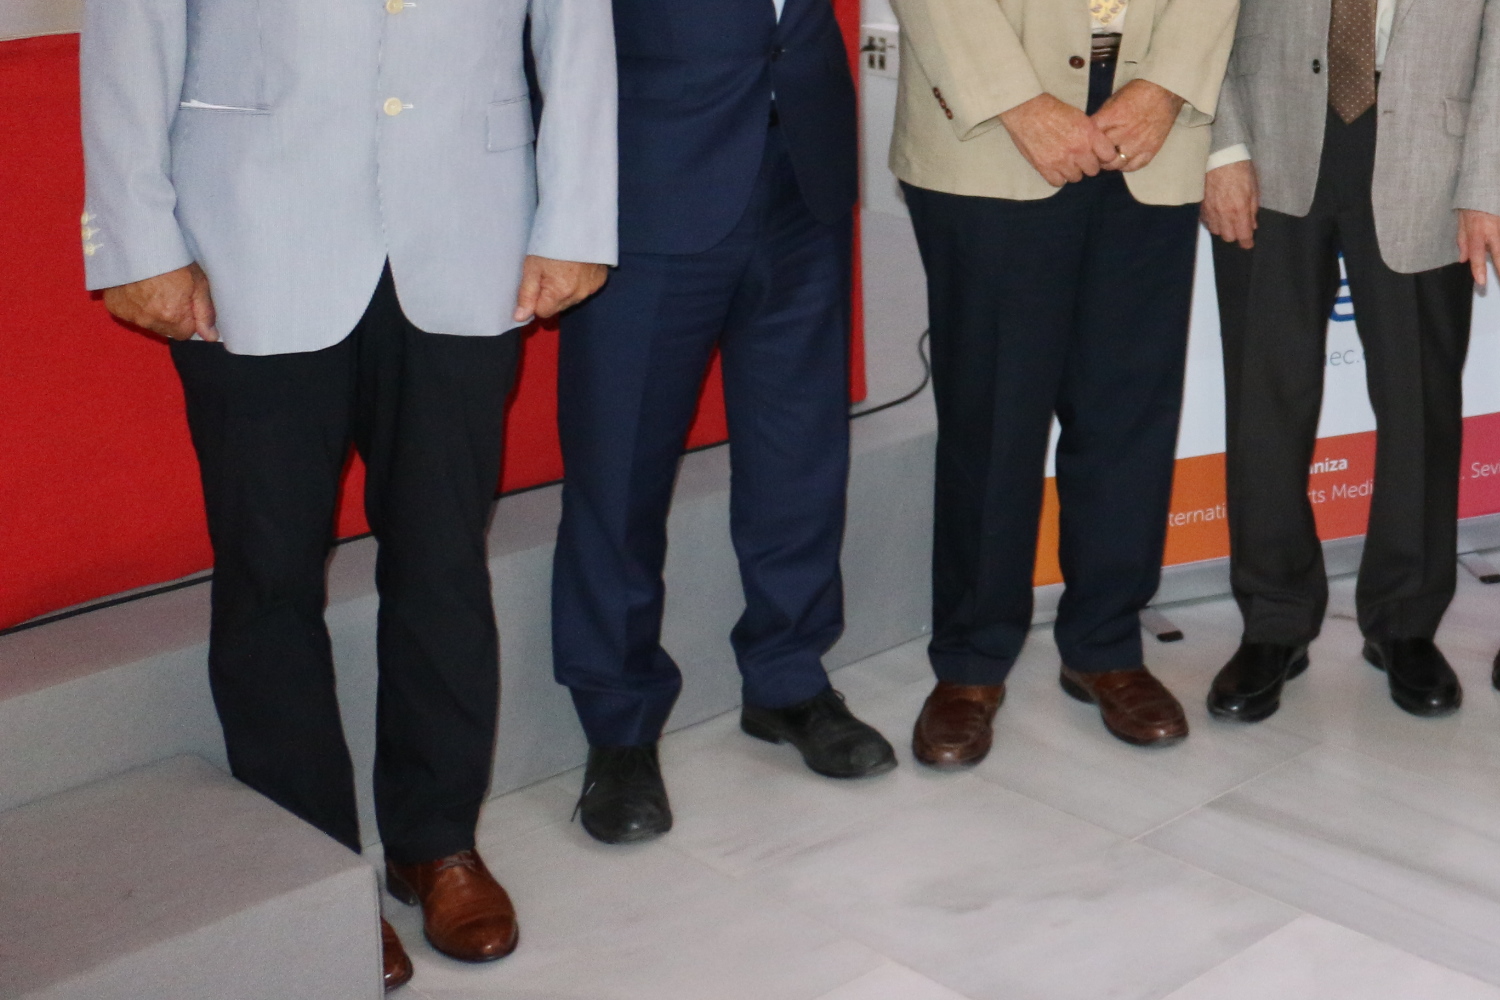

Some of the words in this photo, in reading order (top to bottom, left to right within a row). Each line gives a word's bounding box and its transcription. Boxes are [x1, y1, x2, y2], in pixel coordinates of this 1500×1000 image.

[1329, 348, 1361, 367] ec.
[1167, 502, 1227, 527] ternati
[1331, 478, 1374, 501] Medi
